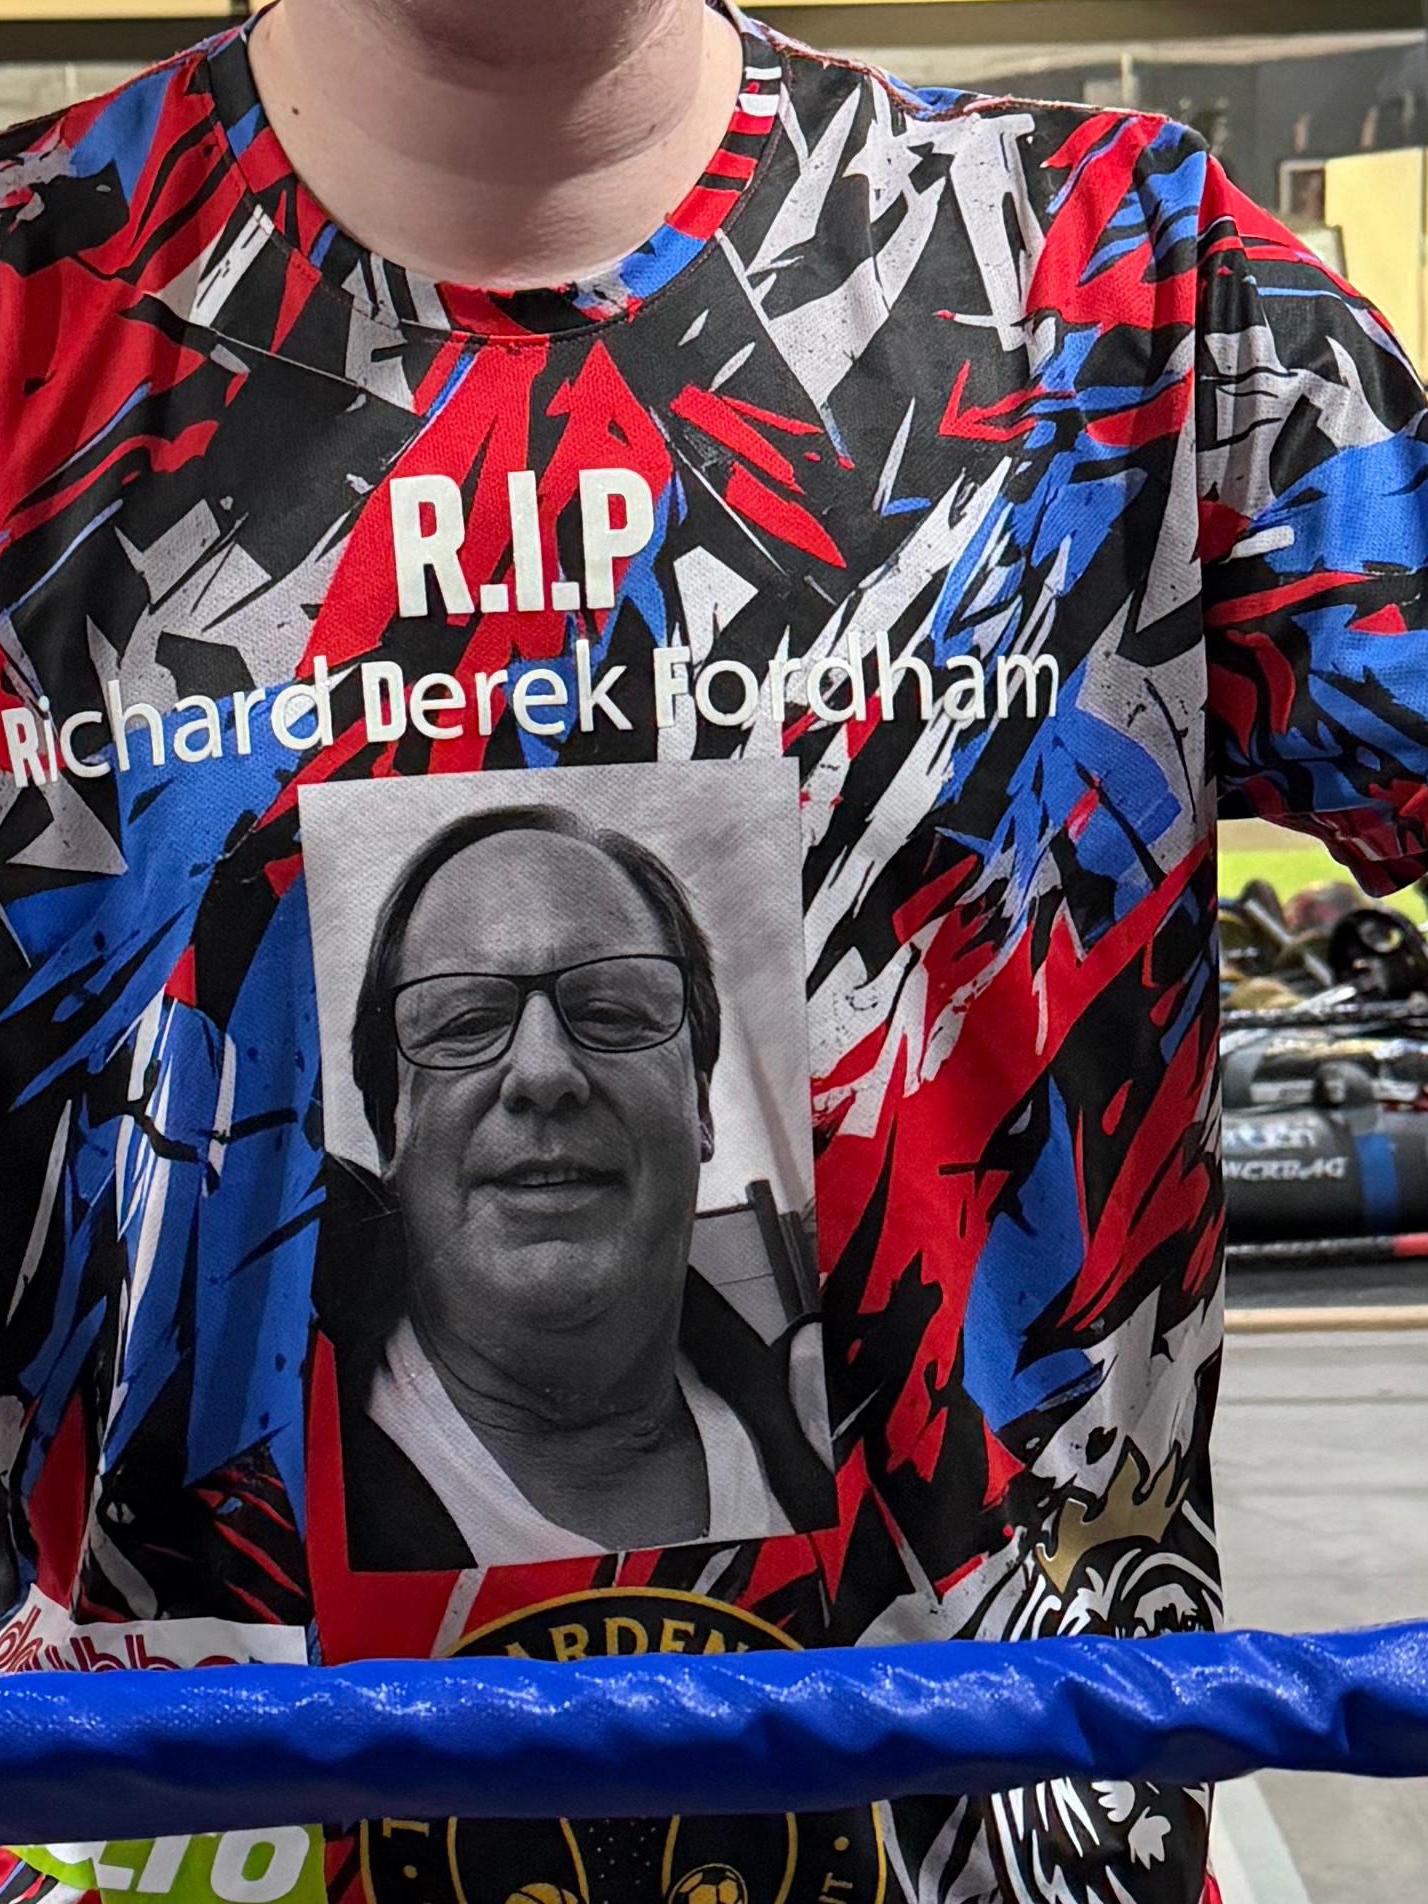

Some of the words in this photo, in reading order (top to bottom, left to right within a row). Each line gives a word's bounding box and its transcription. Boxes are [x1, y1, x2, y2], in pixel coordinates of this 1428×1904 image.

[387, 465, 656, 620] R.I.P
[0, 653, 334, 788] Richard
[362, 638, 634, 745] Derek
[652, 629, 1060, 730] Fordham
